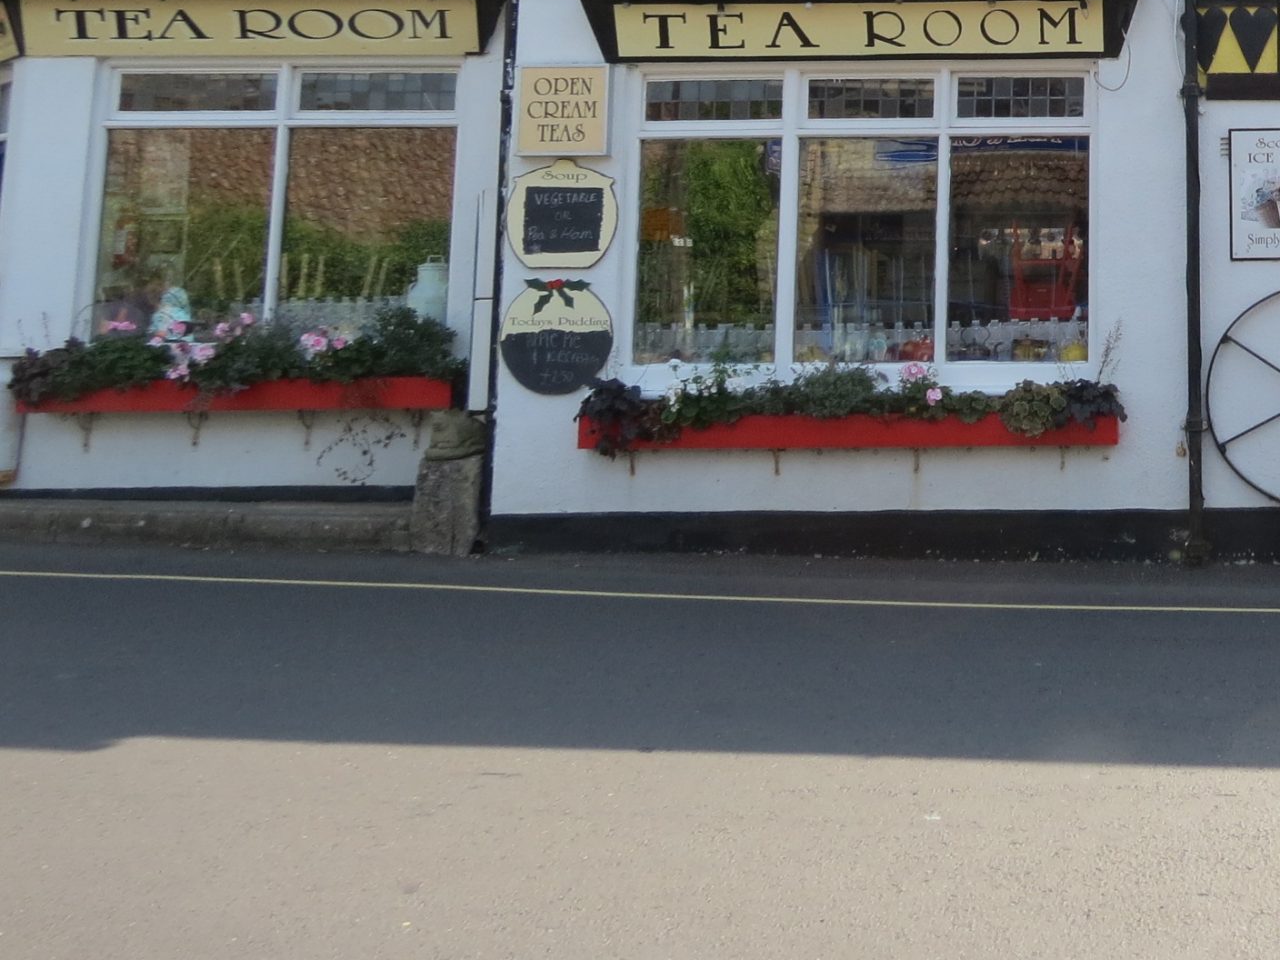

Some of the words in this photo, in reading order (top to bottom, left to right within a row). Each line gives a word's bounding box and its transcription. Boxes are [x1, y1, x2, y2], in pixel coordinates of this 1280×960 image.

[54, 8, 210, 41] TEA
[233, 8, 453, 40] ROOM
[642, 10, 820, 49] TEA
[863, 6, 1084, 47] ROOM
[534, 77, 594, 97] OPEN
[527, 100, 599, 120] CREAM
[537, 123, 586, 143] TEAS
[1248, 152, 1274, 164] ICE
[541, 170, 588, 184] Soup
[534, 192, 598, 208] VEGETABLE
[509, 316, 553, 329] Todays
[558, 316, 609, 329] Pudding
